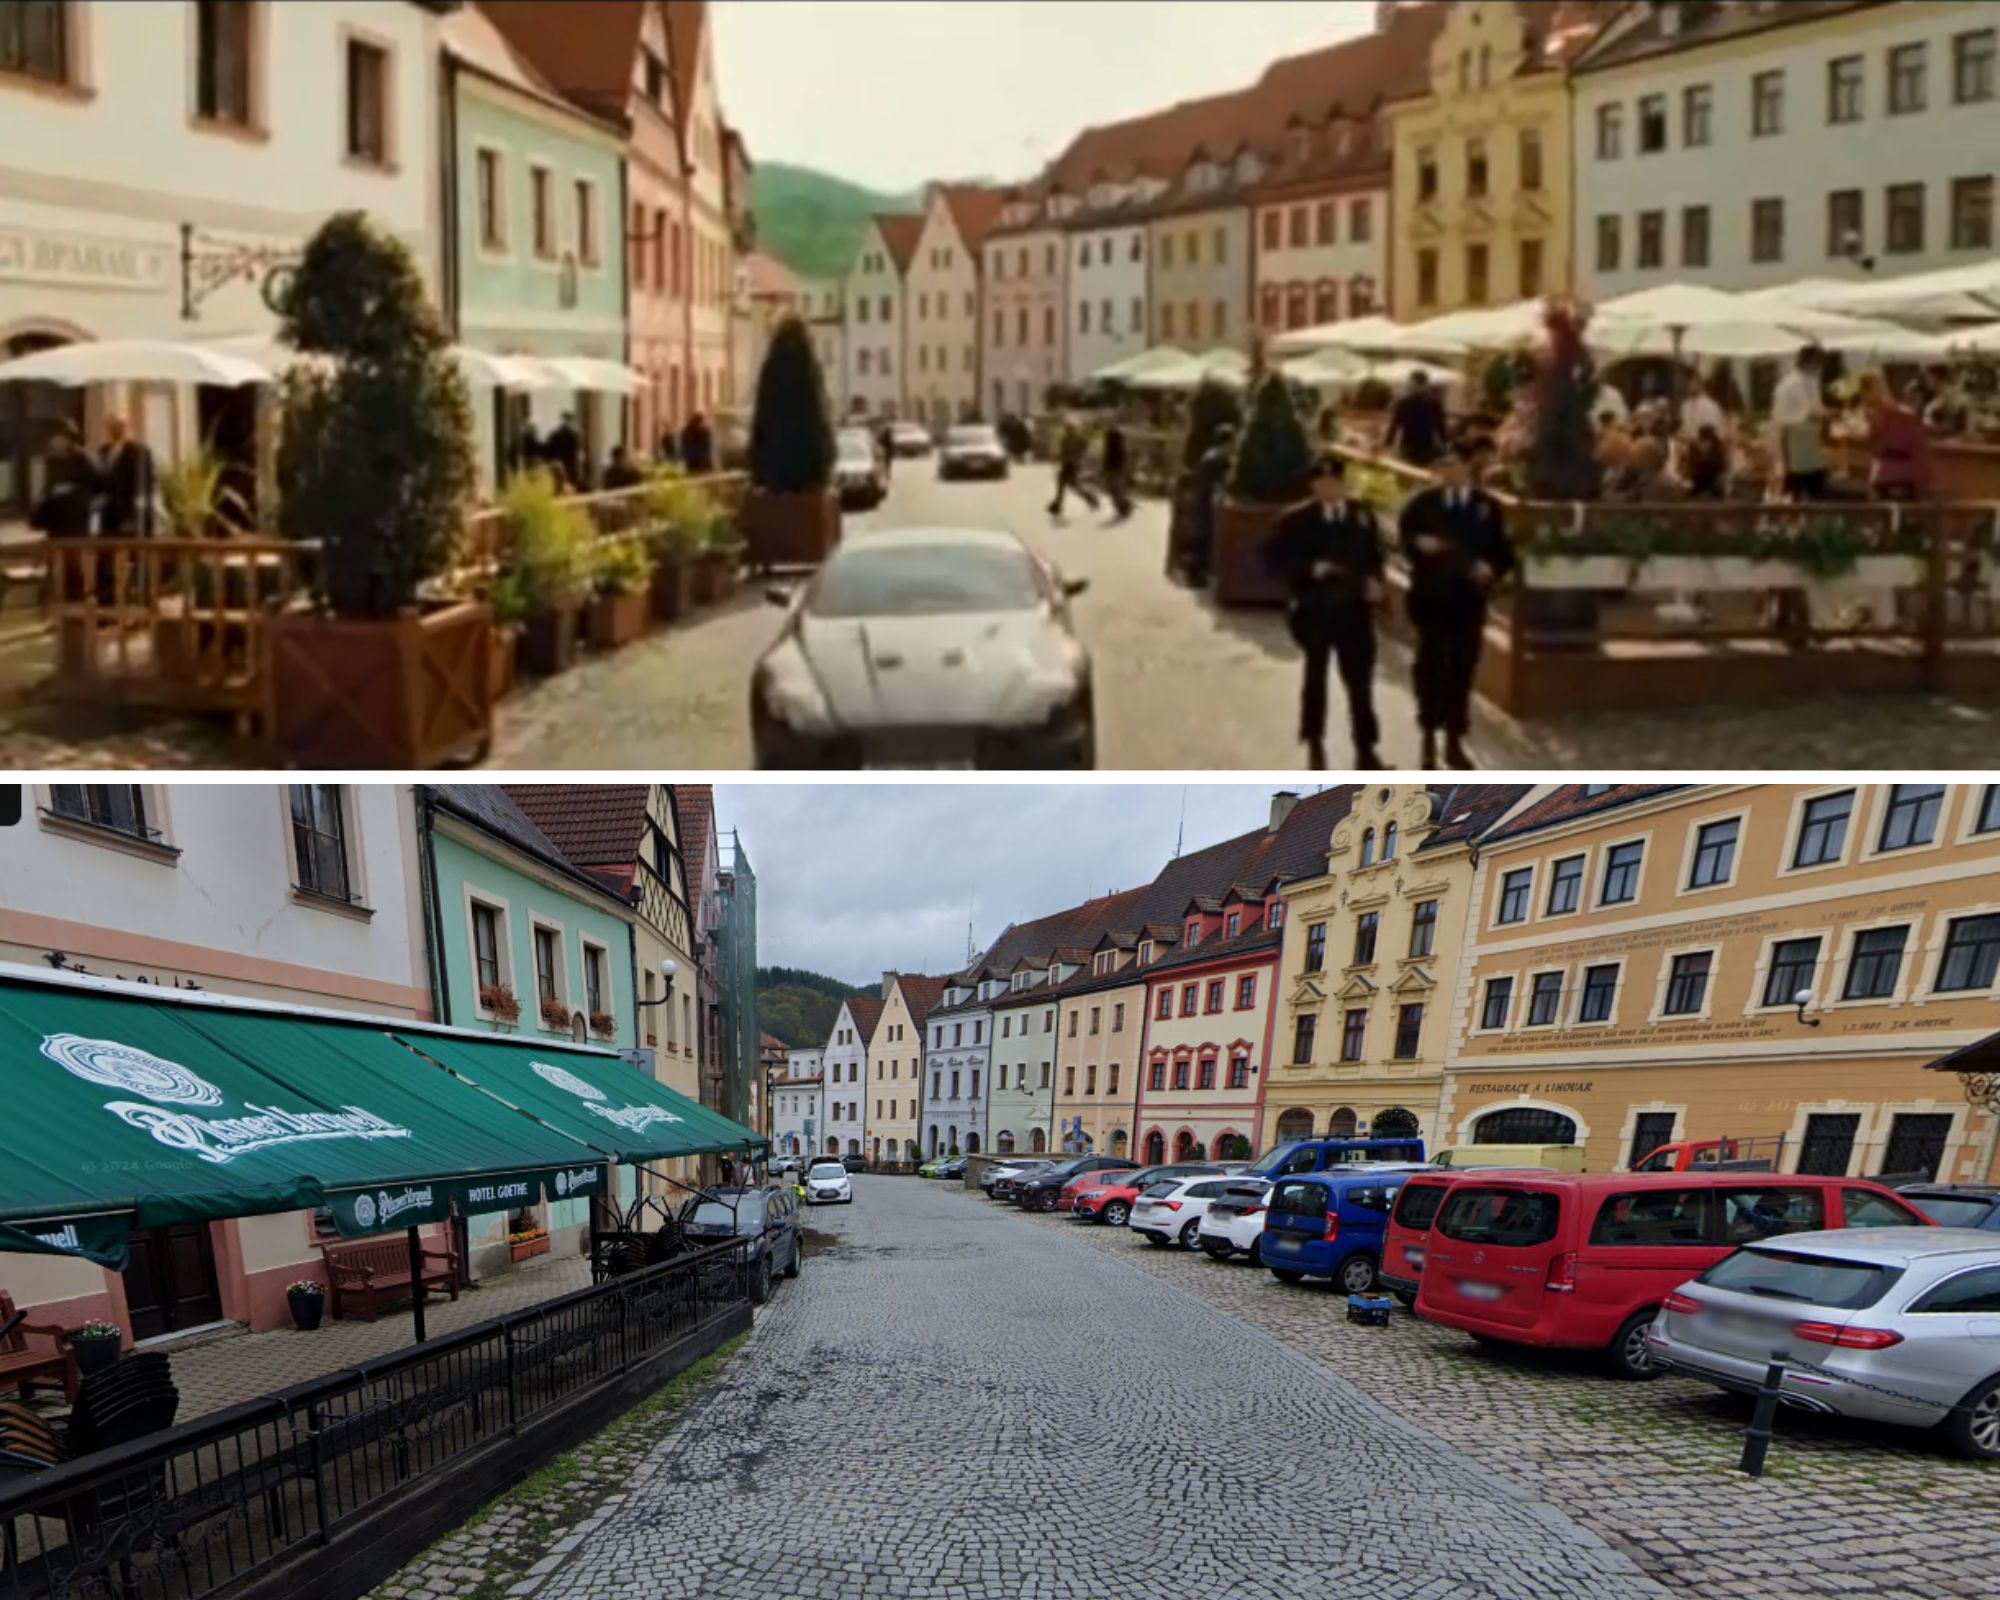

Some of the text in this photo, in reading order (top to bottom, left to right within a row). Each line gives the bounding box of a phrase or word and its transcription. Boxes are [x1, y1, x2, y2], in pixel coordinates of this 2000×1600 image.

[1468, 1083, 1530, 1094] RESTAURACE
[1532, 1083, 1541, 1092] A
[468, 1182, 529, 1202] HOTEL GOETHE
